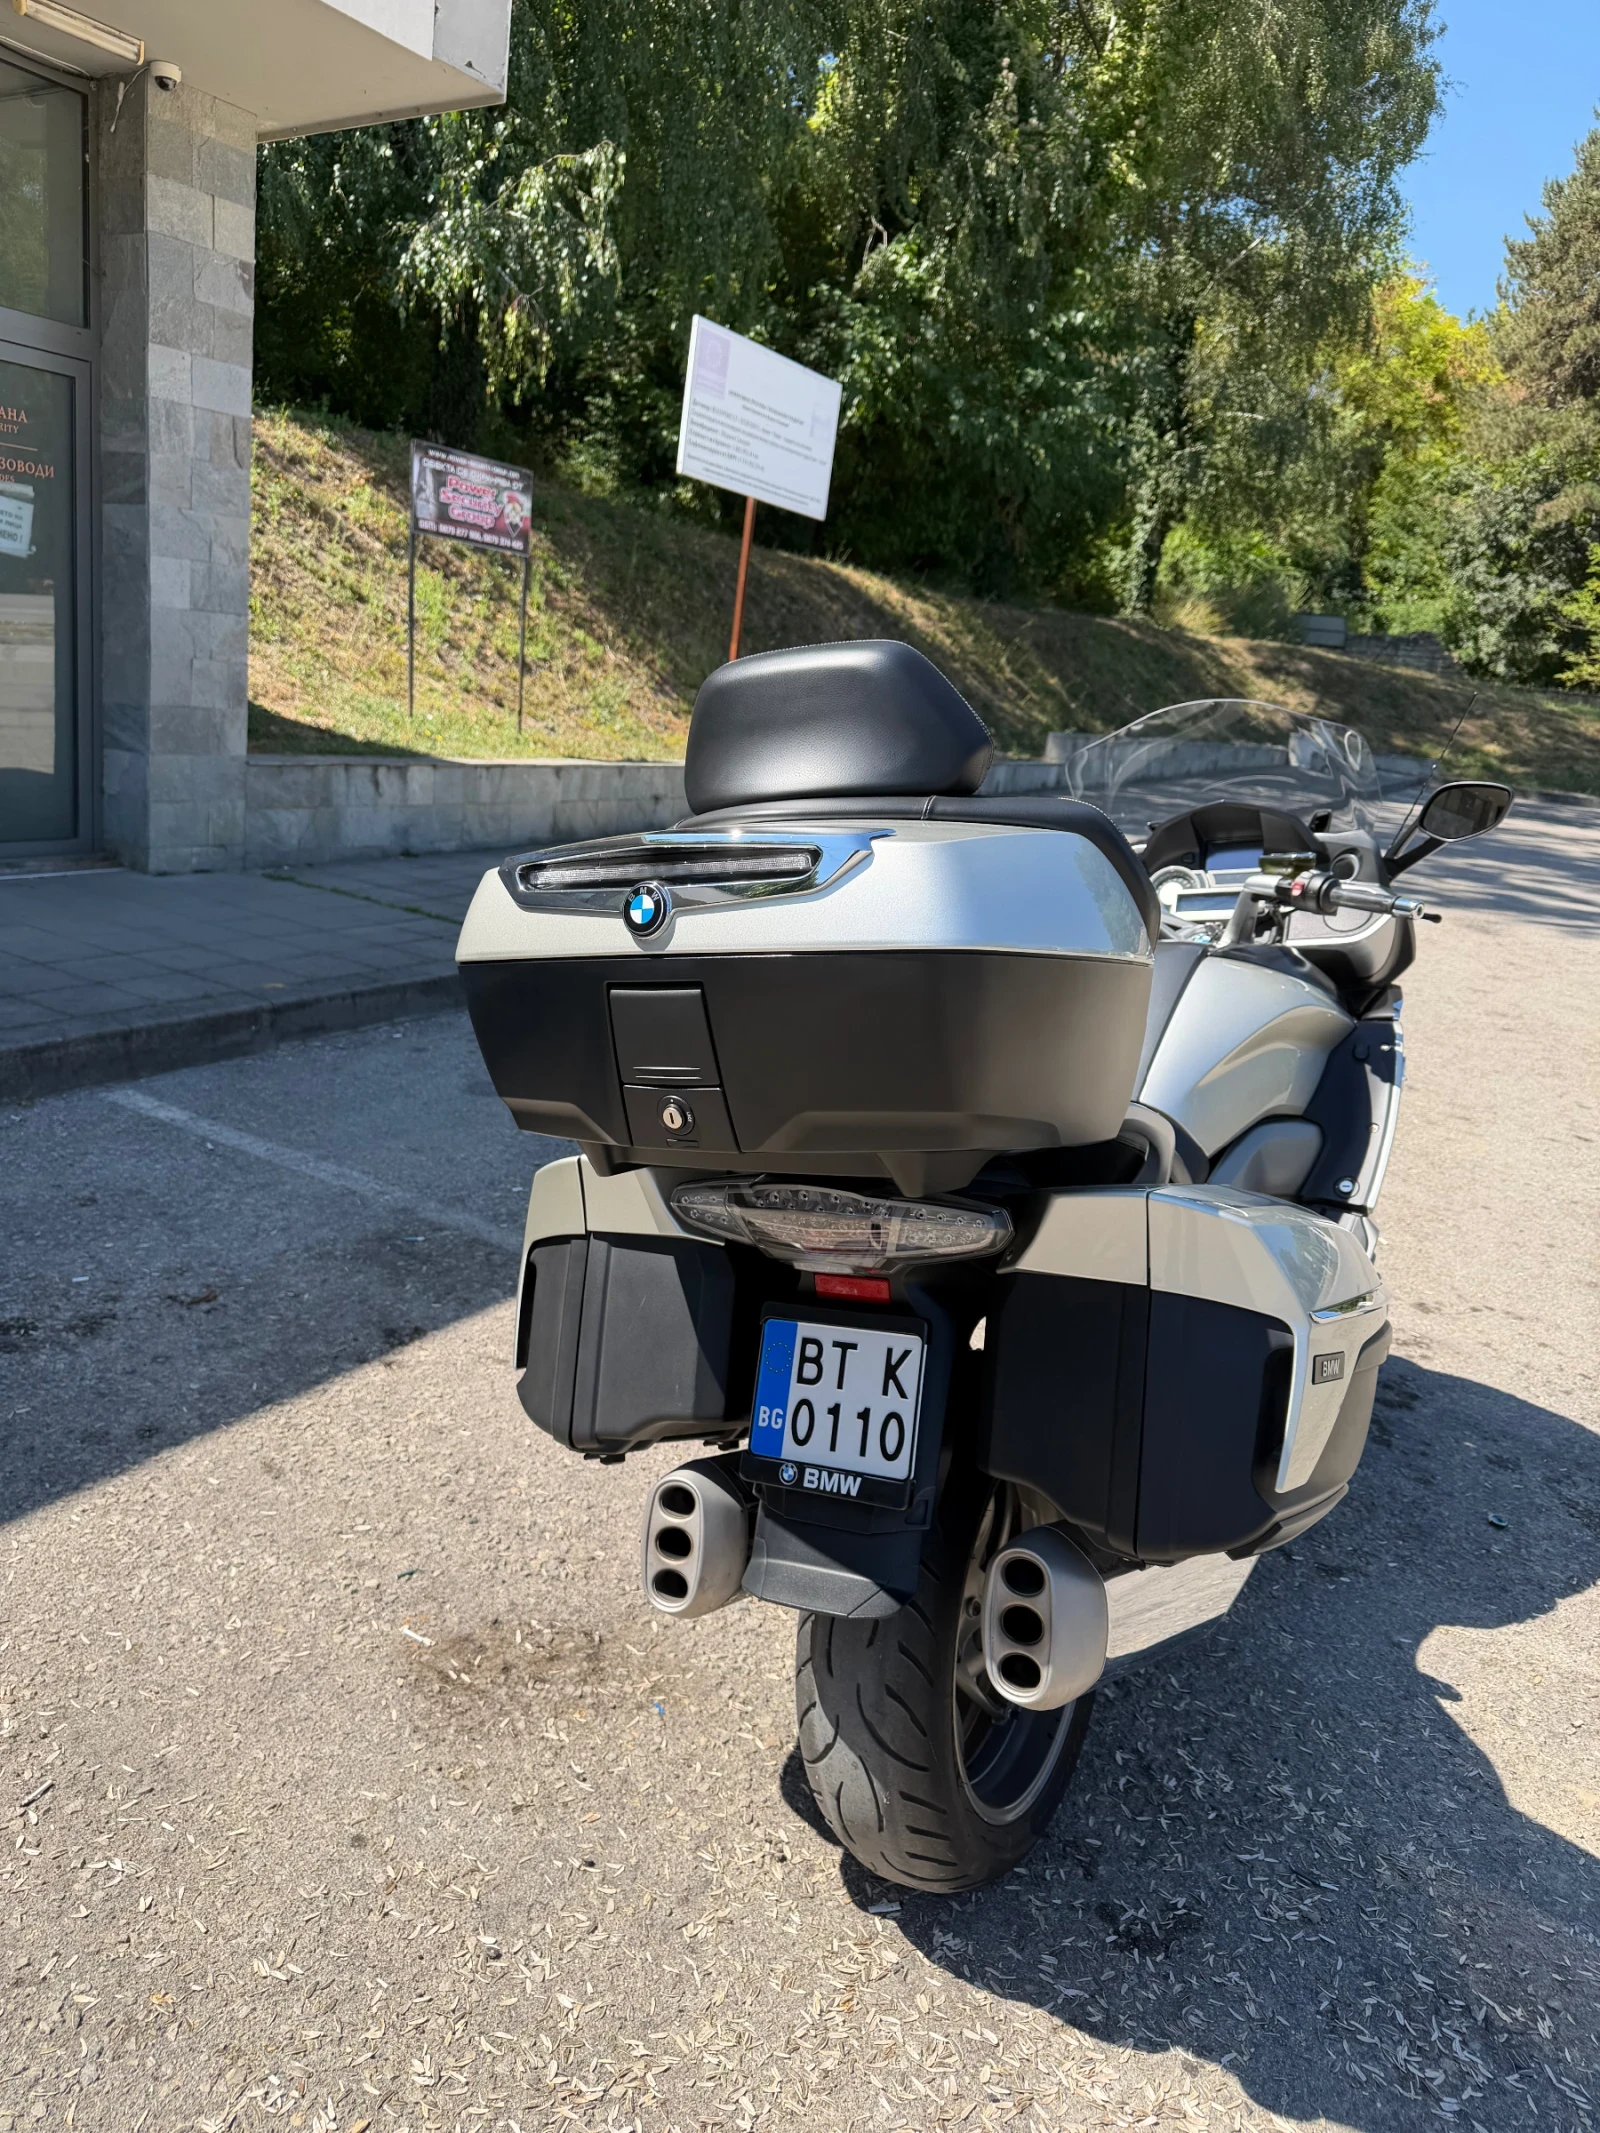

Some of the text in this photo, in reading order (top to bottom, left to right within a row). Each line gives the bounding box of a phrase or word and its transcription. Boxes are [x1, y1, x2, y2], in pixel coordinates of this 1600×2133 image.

[447, 476, 497, 499] Power
[440, 488, 503, 516] Security
[449, 504, 495, 528] Group
[628, 887, 660, 902] BMW
[796, 1336, 913, 1400] BT K
[1322, 1358, 1341, 1377] BMW
[758, 1405, 783, 1430] BG
[791, 1398, 905, 1462] 0110
[803, 1467, 862, 1497] BMW
